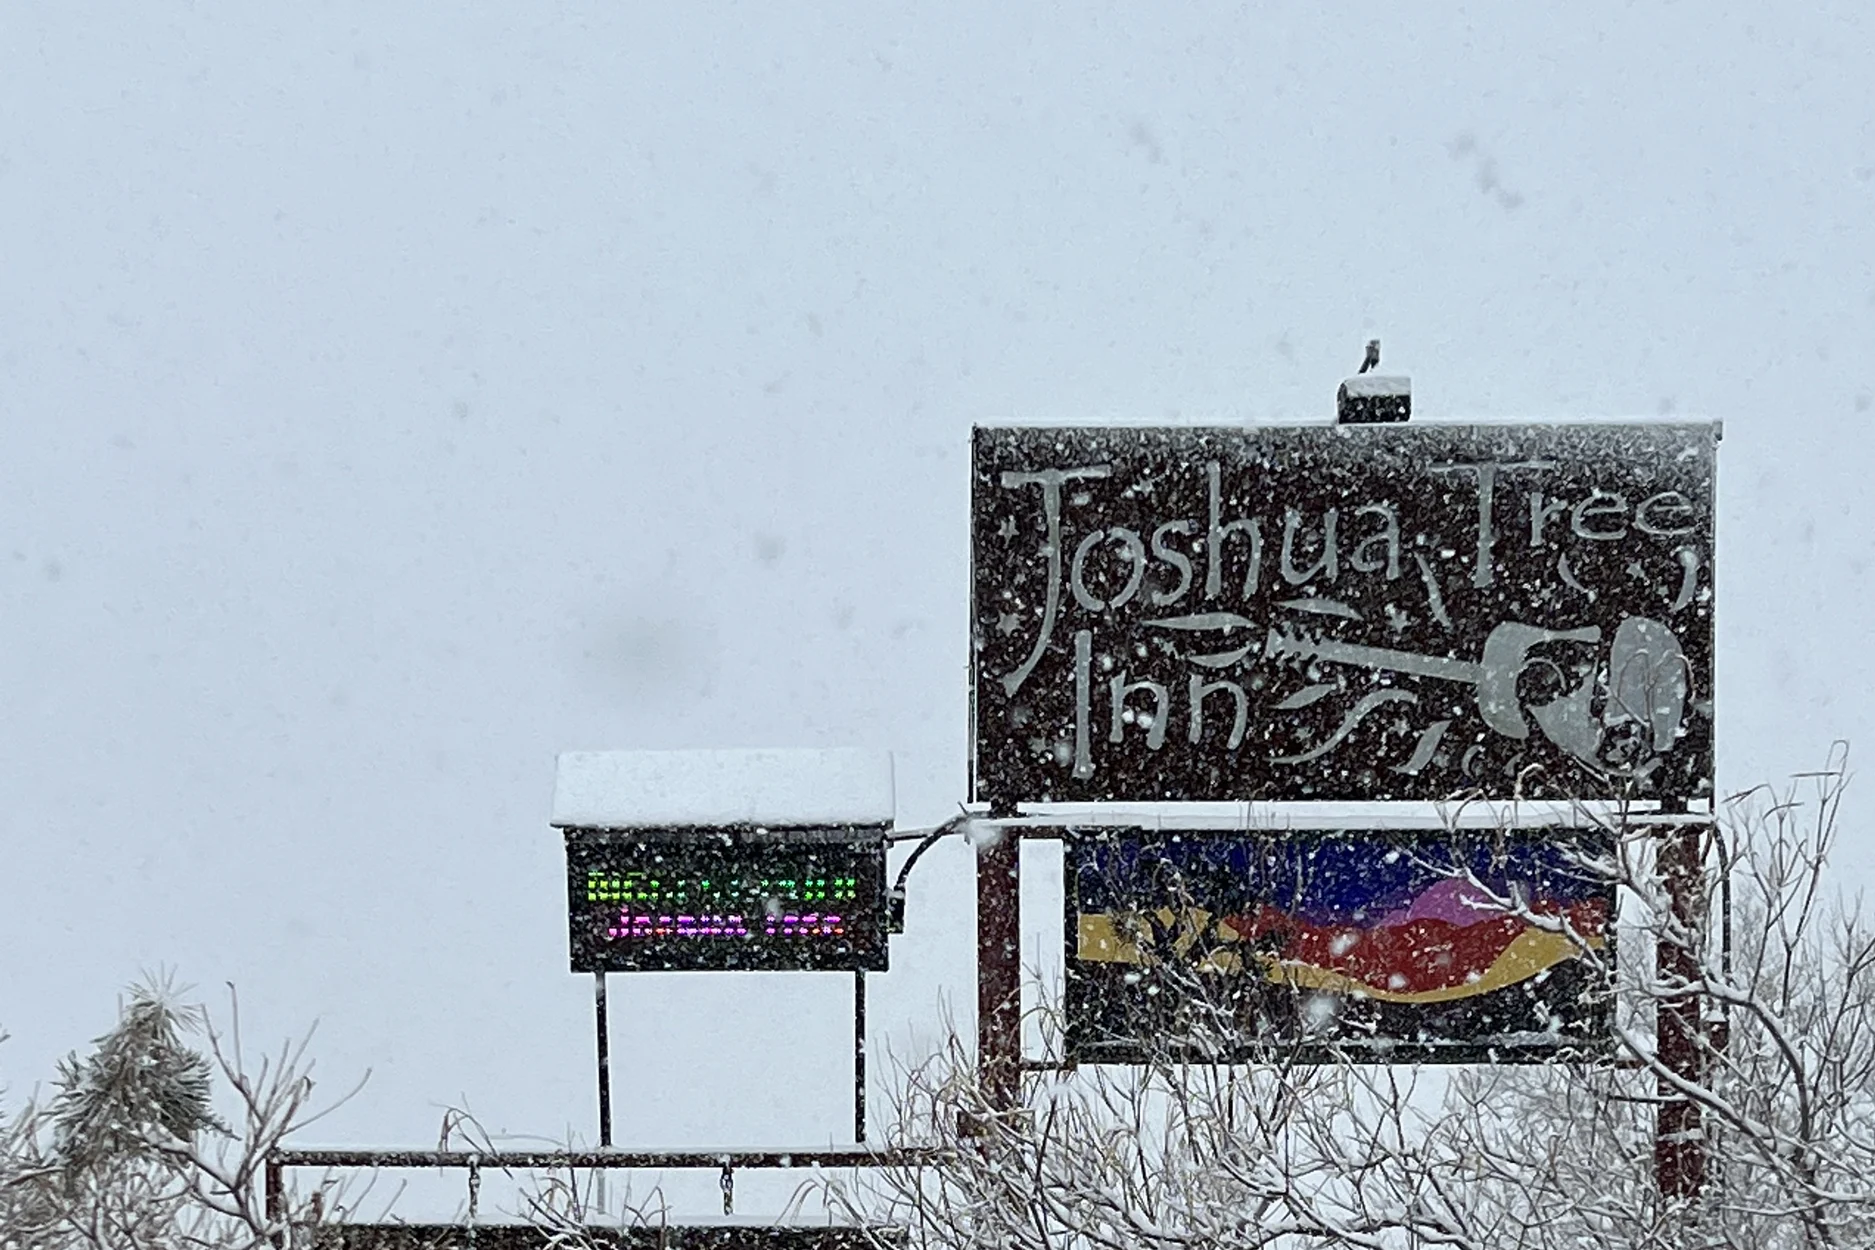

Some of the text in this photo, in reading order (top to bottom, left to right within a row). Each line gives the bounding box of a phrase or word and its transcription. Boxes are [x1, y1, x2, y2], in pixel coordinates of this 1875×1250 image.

[1001, 459, 1697, 698] Joshua Tree
[1074, 629, 1250, 780] Inn
